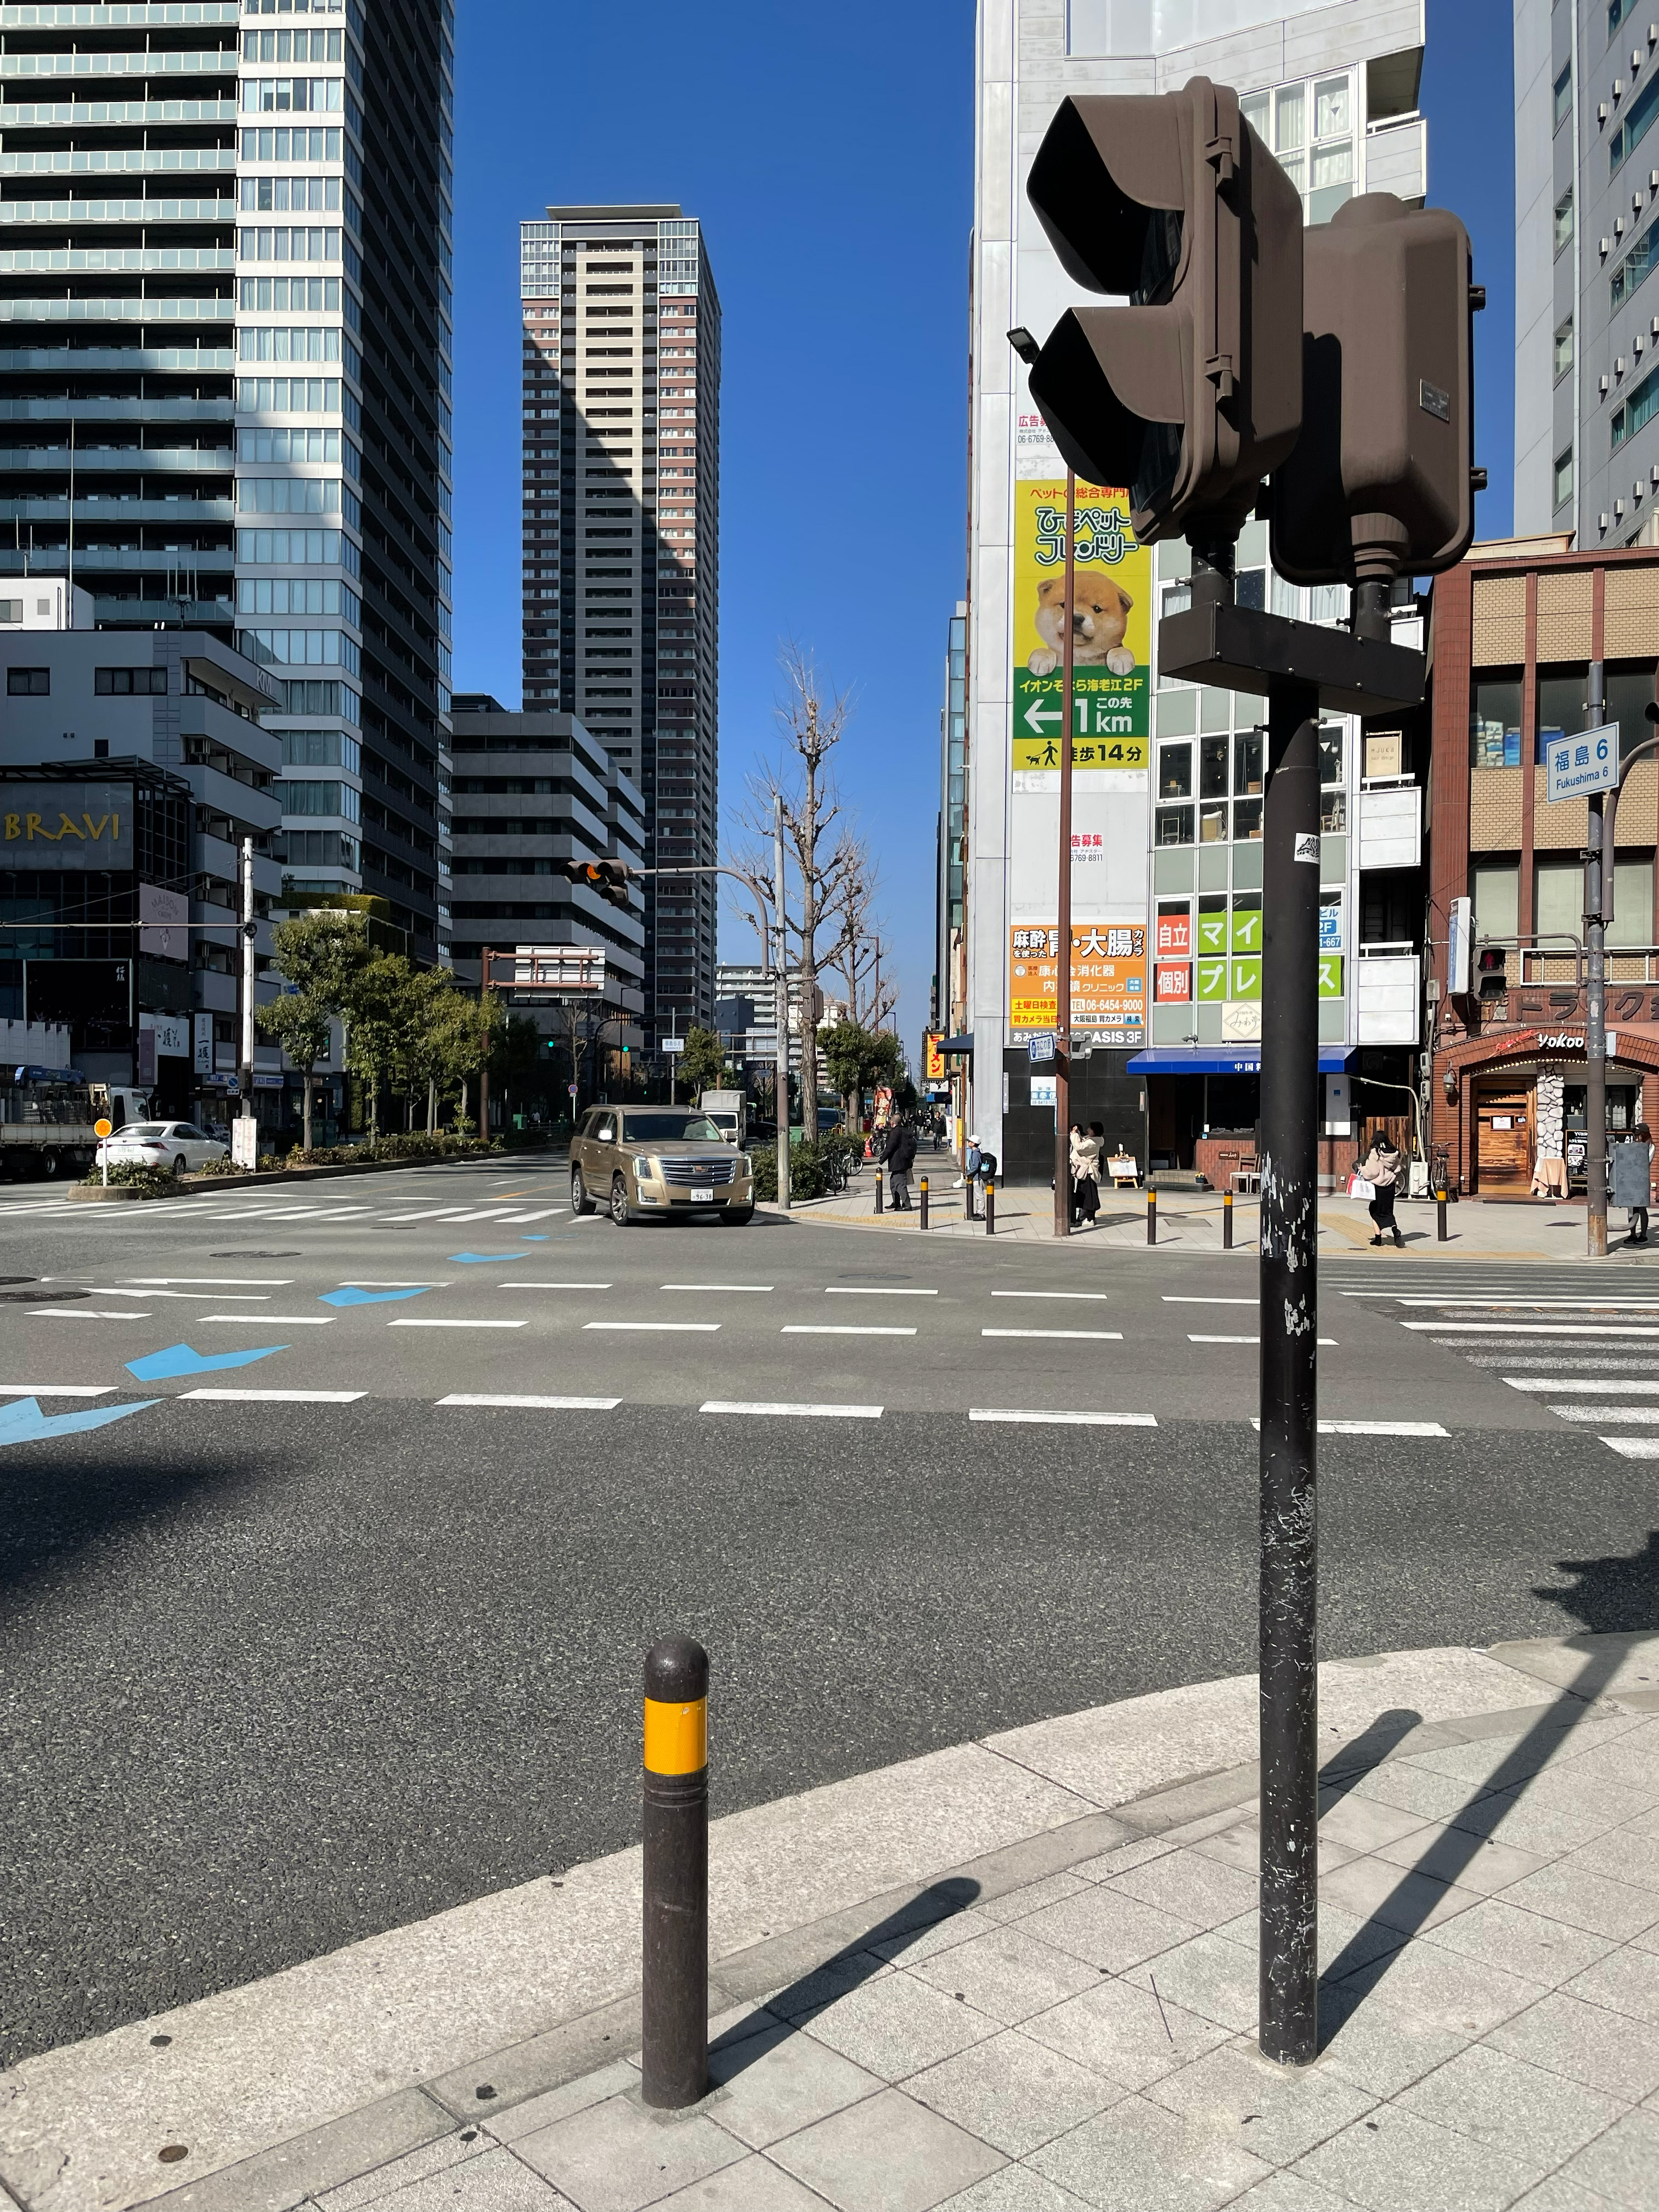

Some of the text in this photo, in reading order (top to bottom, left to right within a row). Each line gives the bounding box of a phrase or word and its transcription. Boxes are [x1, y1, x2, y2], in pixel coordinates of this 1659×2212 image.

[1030, 488, 1129, 499] ペット総合専門
[1020, 679, 1143, 693] イオンそら海老江2F
[1096, 697, 1132, 709] この先
[1075, 698, 1132, 732] 1 km
[1556, 766, 1608, 790] Fukushima 6
[4, 812, 119, 840] BRAVI
[1013, 929, 1047, 949] 麻酔
[1159, 923, 1188, 948] 自立
[1133, 929, 1144, 957] カメラ
[1013, 950, 1047, 958] を使った
[1158, 970, 1188, 995] 個別
[1015, 1000, 1057, 1010] 土曜日検査
[1072, 1000, 1143, 1011] TEL 06-6454-9000
[1074, 1015, 1097, 1023] 大阪福島
[1099, 1015, 1122, 1023] 胃カメラ
[1126, 1031, 1142, 1043] 3F
